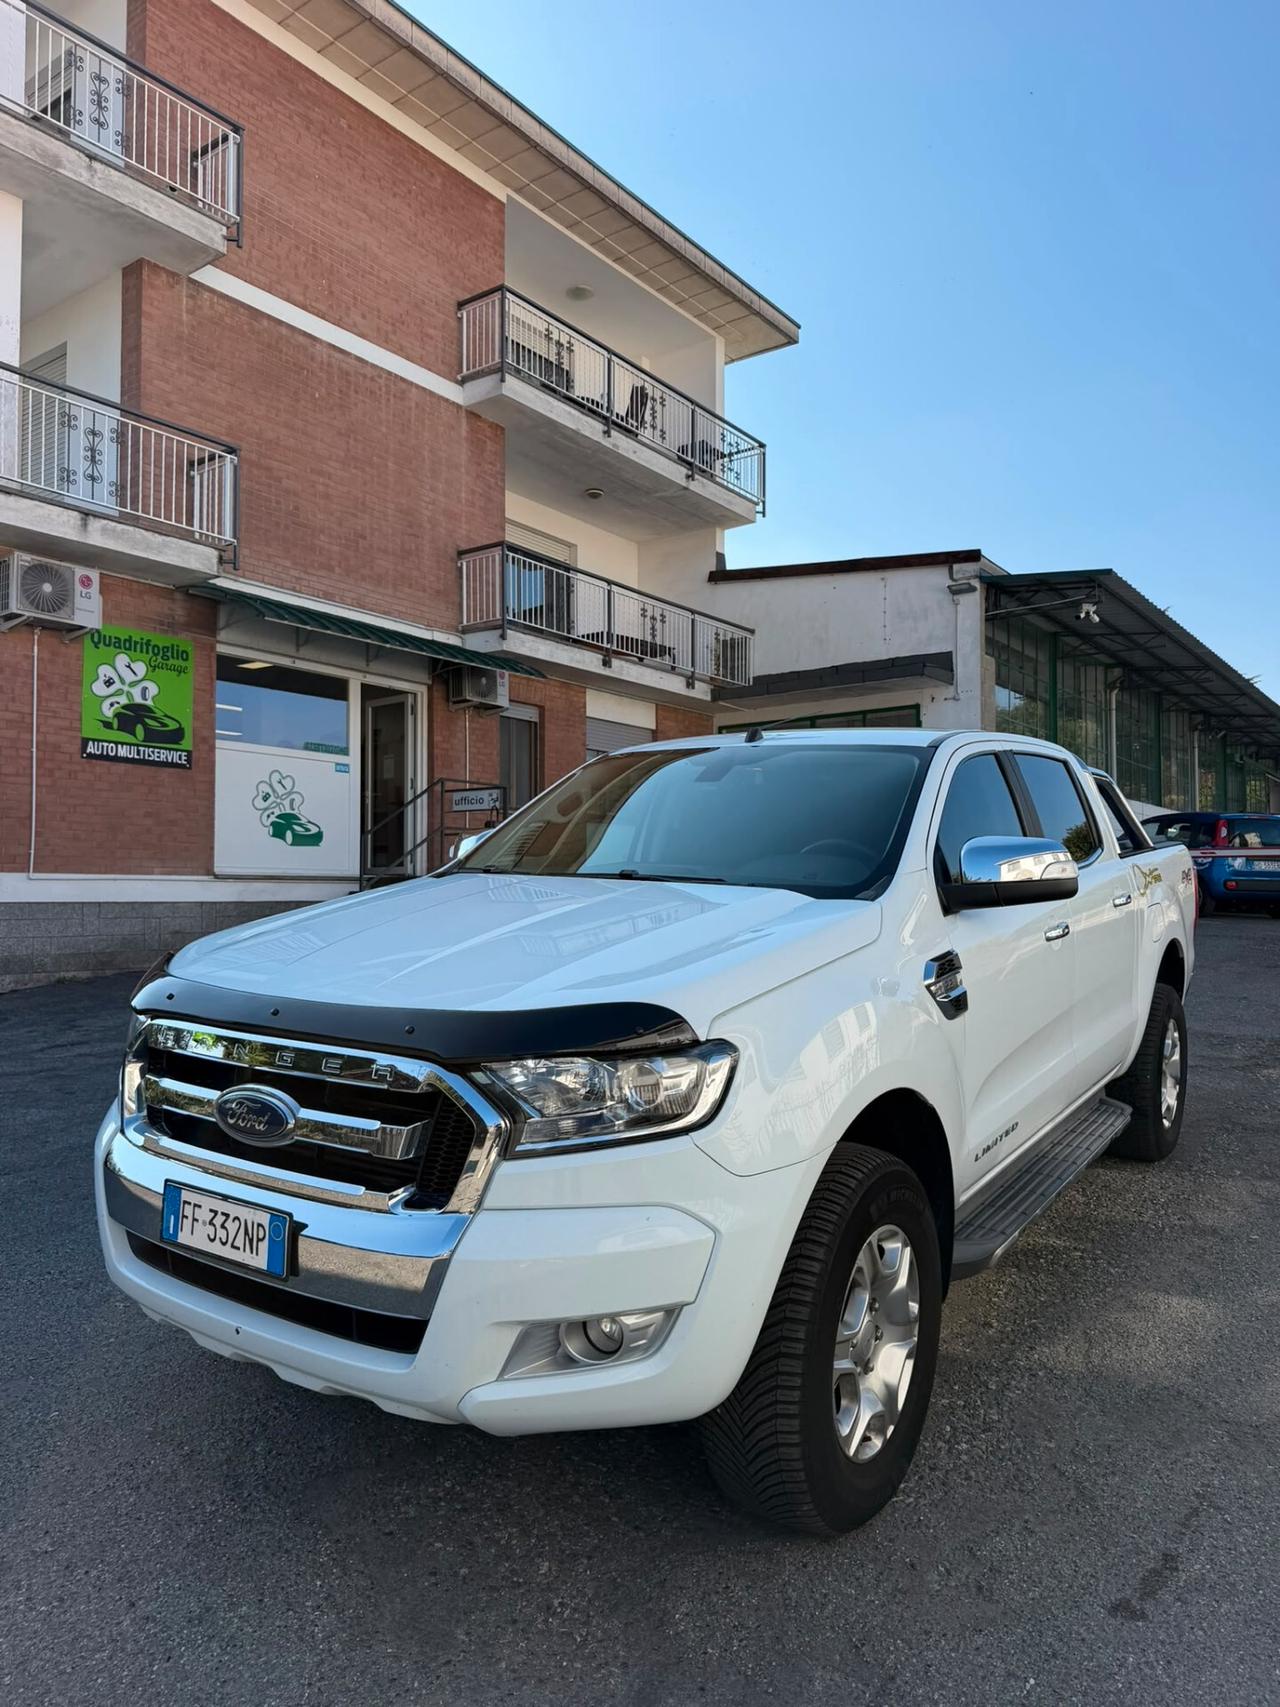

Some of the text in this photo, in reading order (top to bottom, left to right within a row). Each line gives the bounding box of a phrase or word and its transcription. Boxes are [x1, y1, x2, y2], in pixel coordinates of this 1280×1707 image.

[80, 590, 92, 600] LG
[90, 629, 190, 662] Quadrifoglio
[148, 656, 189, 677] Garage
[86, 741, 188, 765] AUTO MULTISERVICE
[454, 795, 485, 807] ufficio
[227, 1098, 271, 1131] Ford
[974, 1121, 1019, 1162] LIMITED
